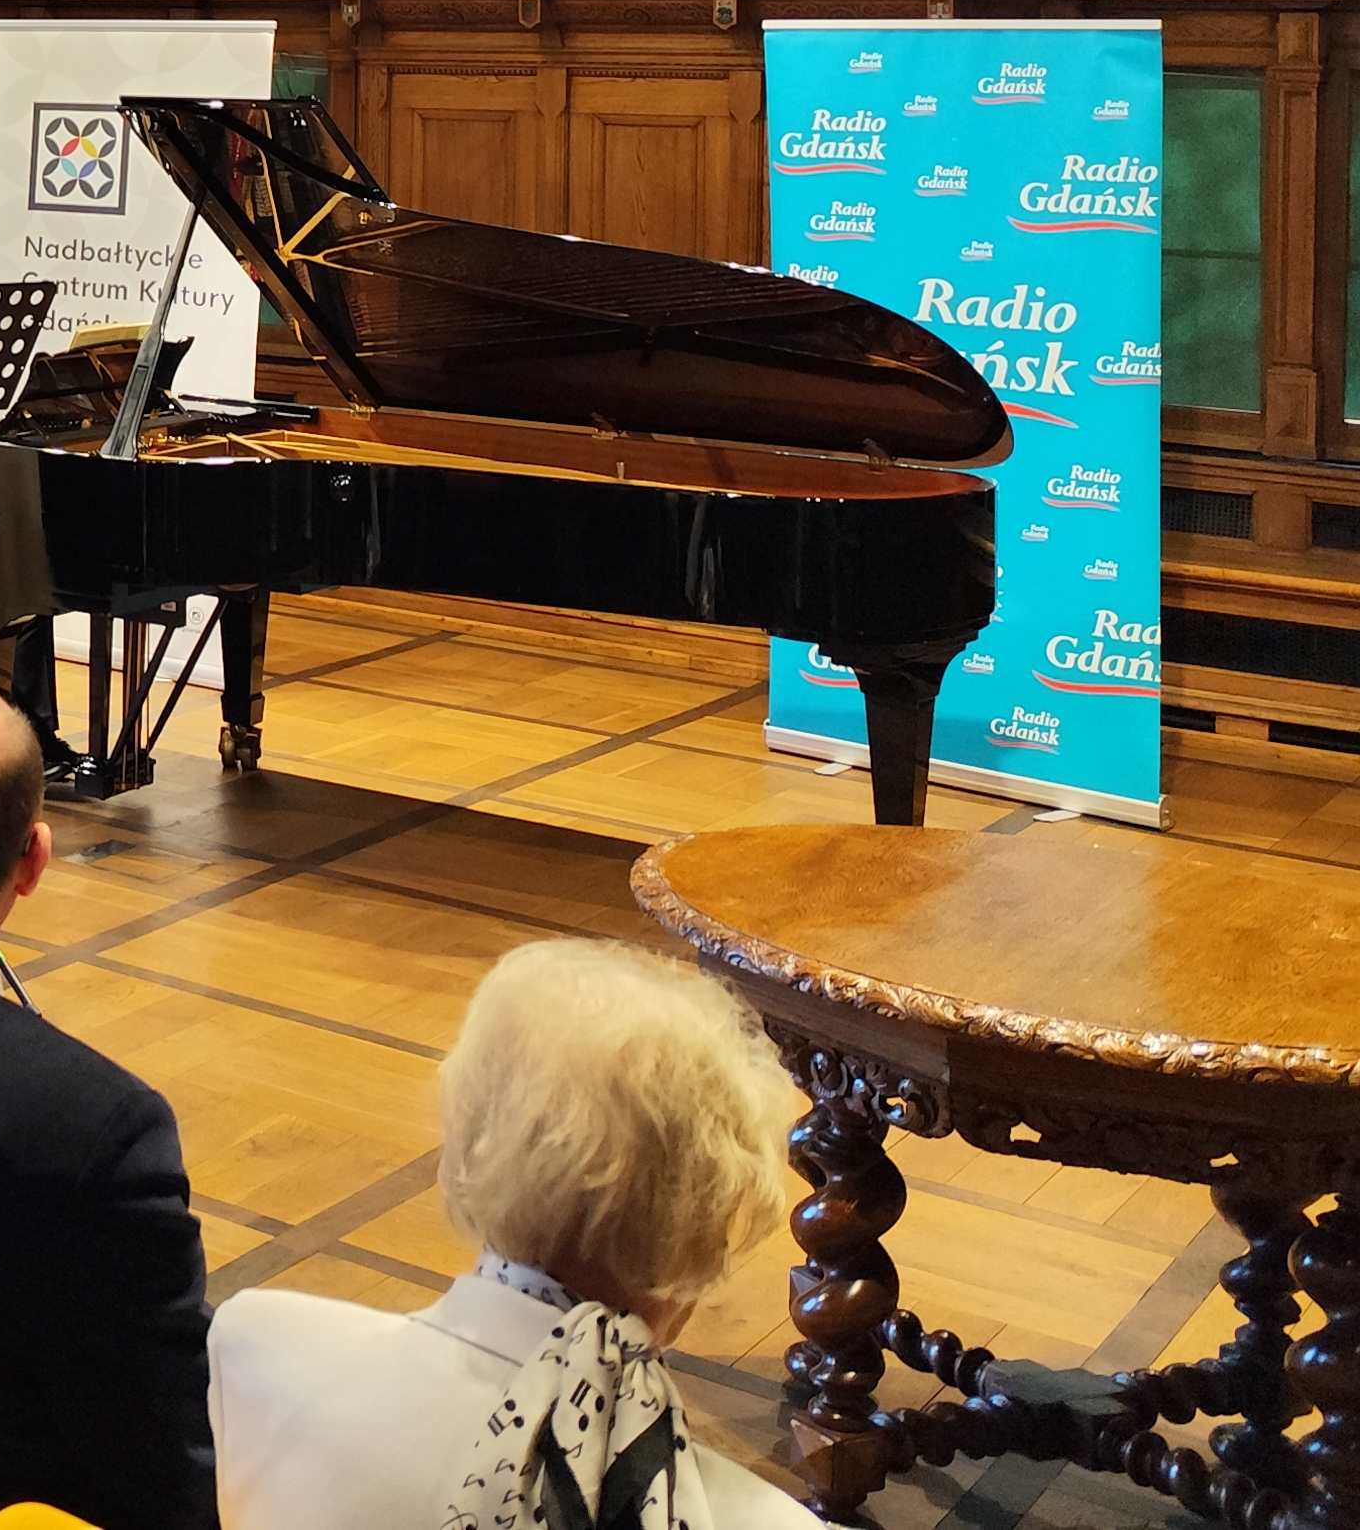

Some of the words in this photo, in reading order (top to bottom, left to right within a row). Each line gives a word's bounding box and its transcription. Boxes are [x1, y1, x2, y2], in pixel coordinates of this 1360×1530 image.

[1000, 62, 1047, 77] Radio
[977, 77, 1046, 95] Gdańsk
[811, 109, 886, 132] Radio
[780, 132, 887, 160] Gdańsk
[933, 165, 968, 177] Radio
[1061, 154, 1158, 183] Radio
[830, 201, 876, 217] Radio
[1019, 182, 1160, 217] Gdańsk
[809, 215, 876, 233] Gdańsk
[24, 235, 203, 272] Nadbałtycke
[788, 263, 839, 282] Radio
[22, 271, 128, 301] ntrum
[139, 279, 235, 315] Ktury
[913, 278, 1077, 334] Radio
[961, 340, 1080, 396] ńsk
[1070, 464, 1121, 484] Radio
[1047, 478, 1121, 503] Gdańsk
[1046, 635, 1162, 683] Gdań
[1012, 706, 1060, 727] Radio
[990, 718, 1059, 746] Gdańsk
